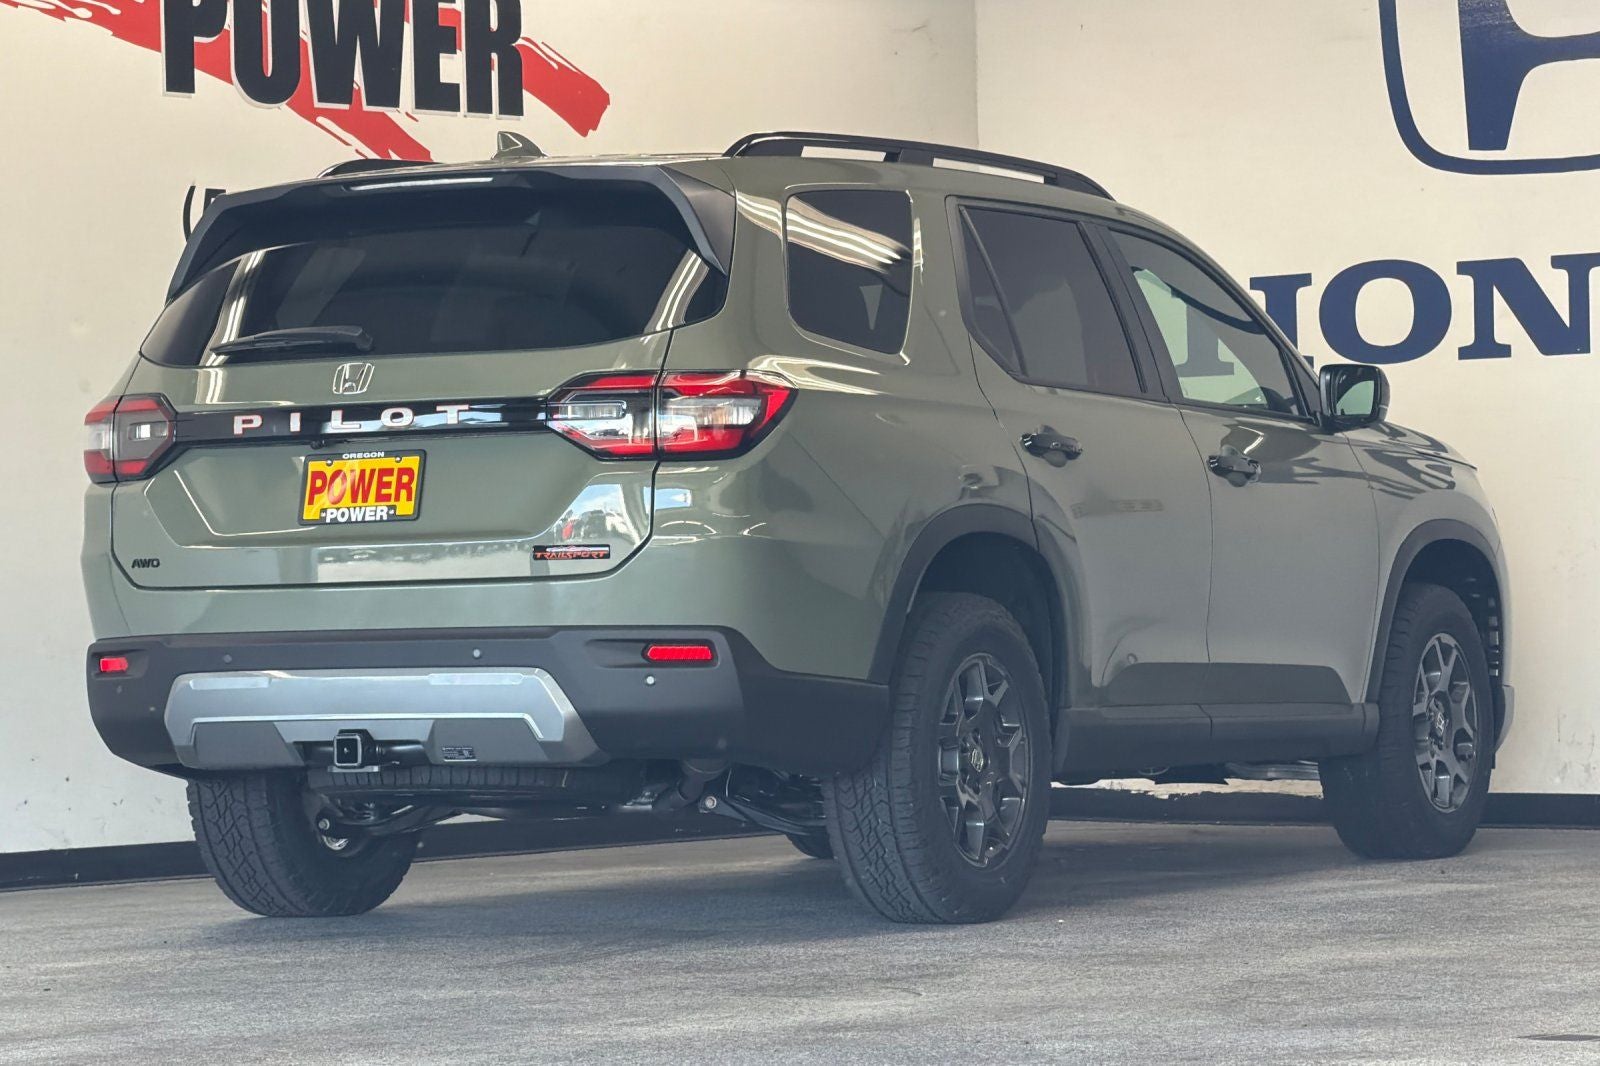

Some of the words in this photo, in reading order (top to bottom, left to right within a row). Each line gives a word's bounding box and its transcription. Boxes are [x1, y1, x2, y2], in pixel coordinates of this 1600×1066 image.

[162, 0, 524, 118] POWER
[233, 404, 469, 435] PILOT
[342, 451, 385, 459] OREGON
[307, 467, 415, 505] POWER
[325, 506, 388, 523] POWER
[131, 558, 160, 569] AWD
[534, 551, 608, 559] TRAILSPORT
